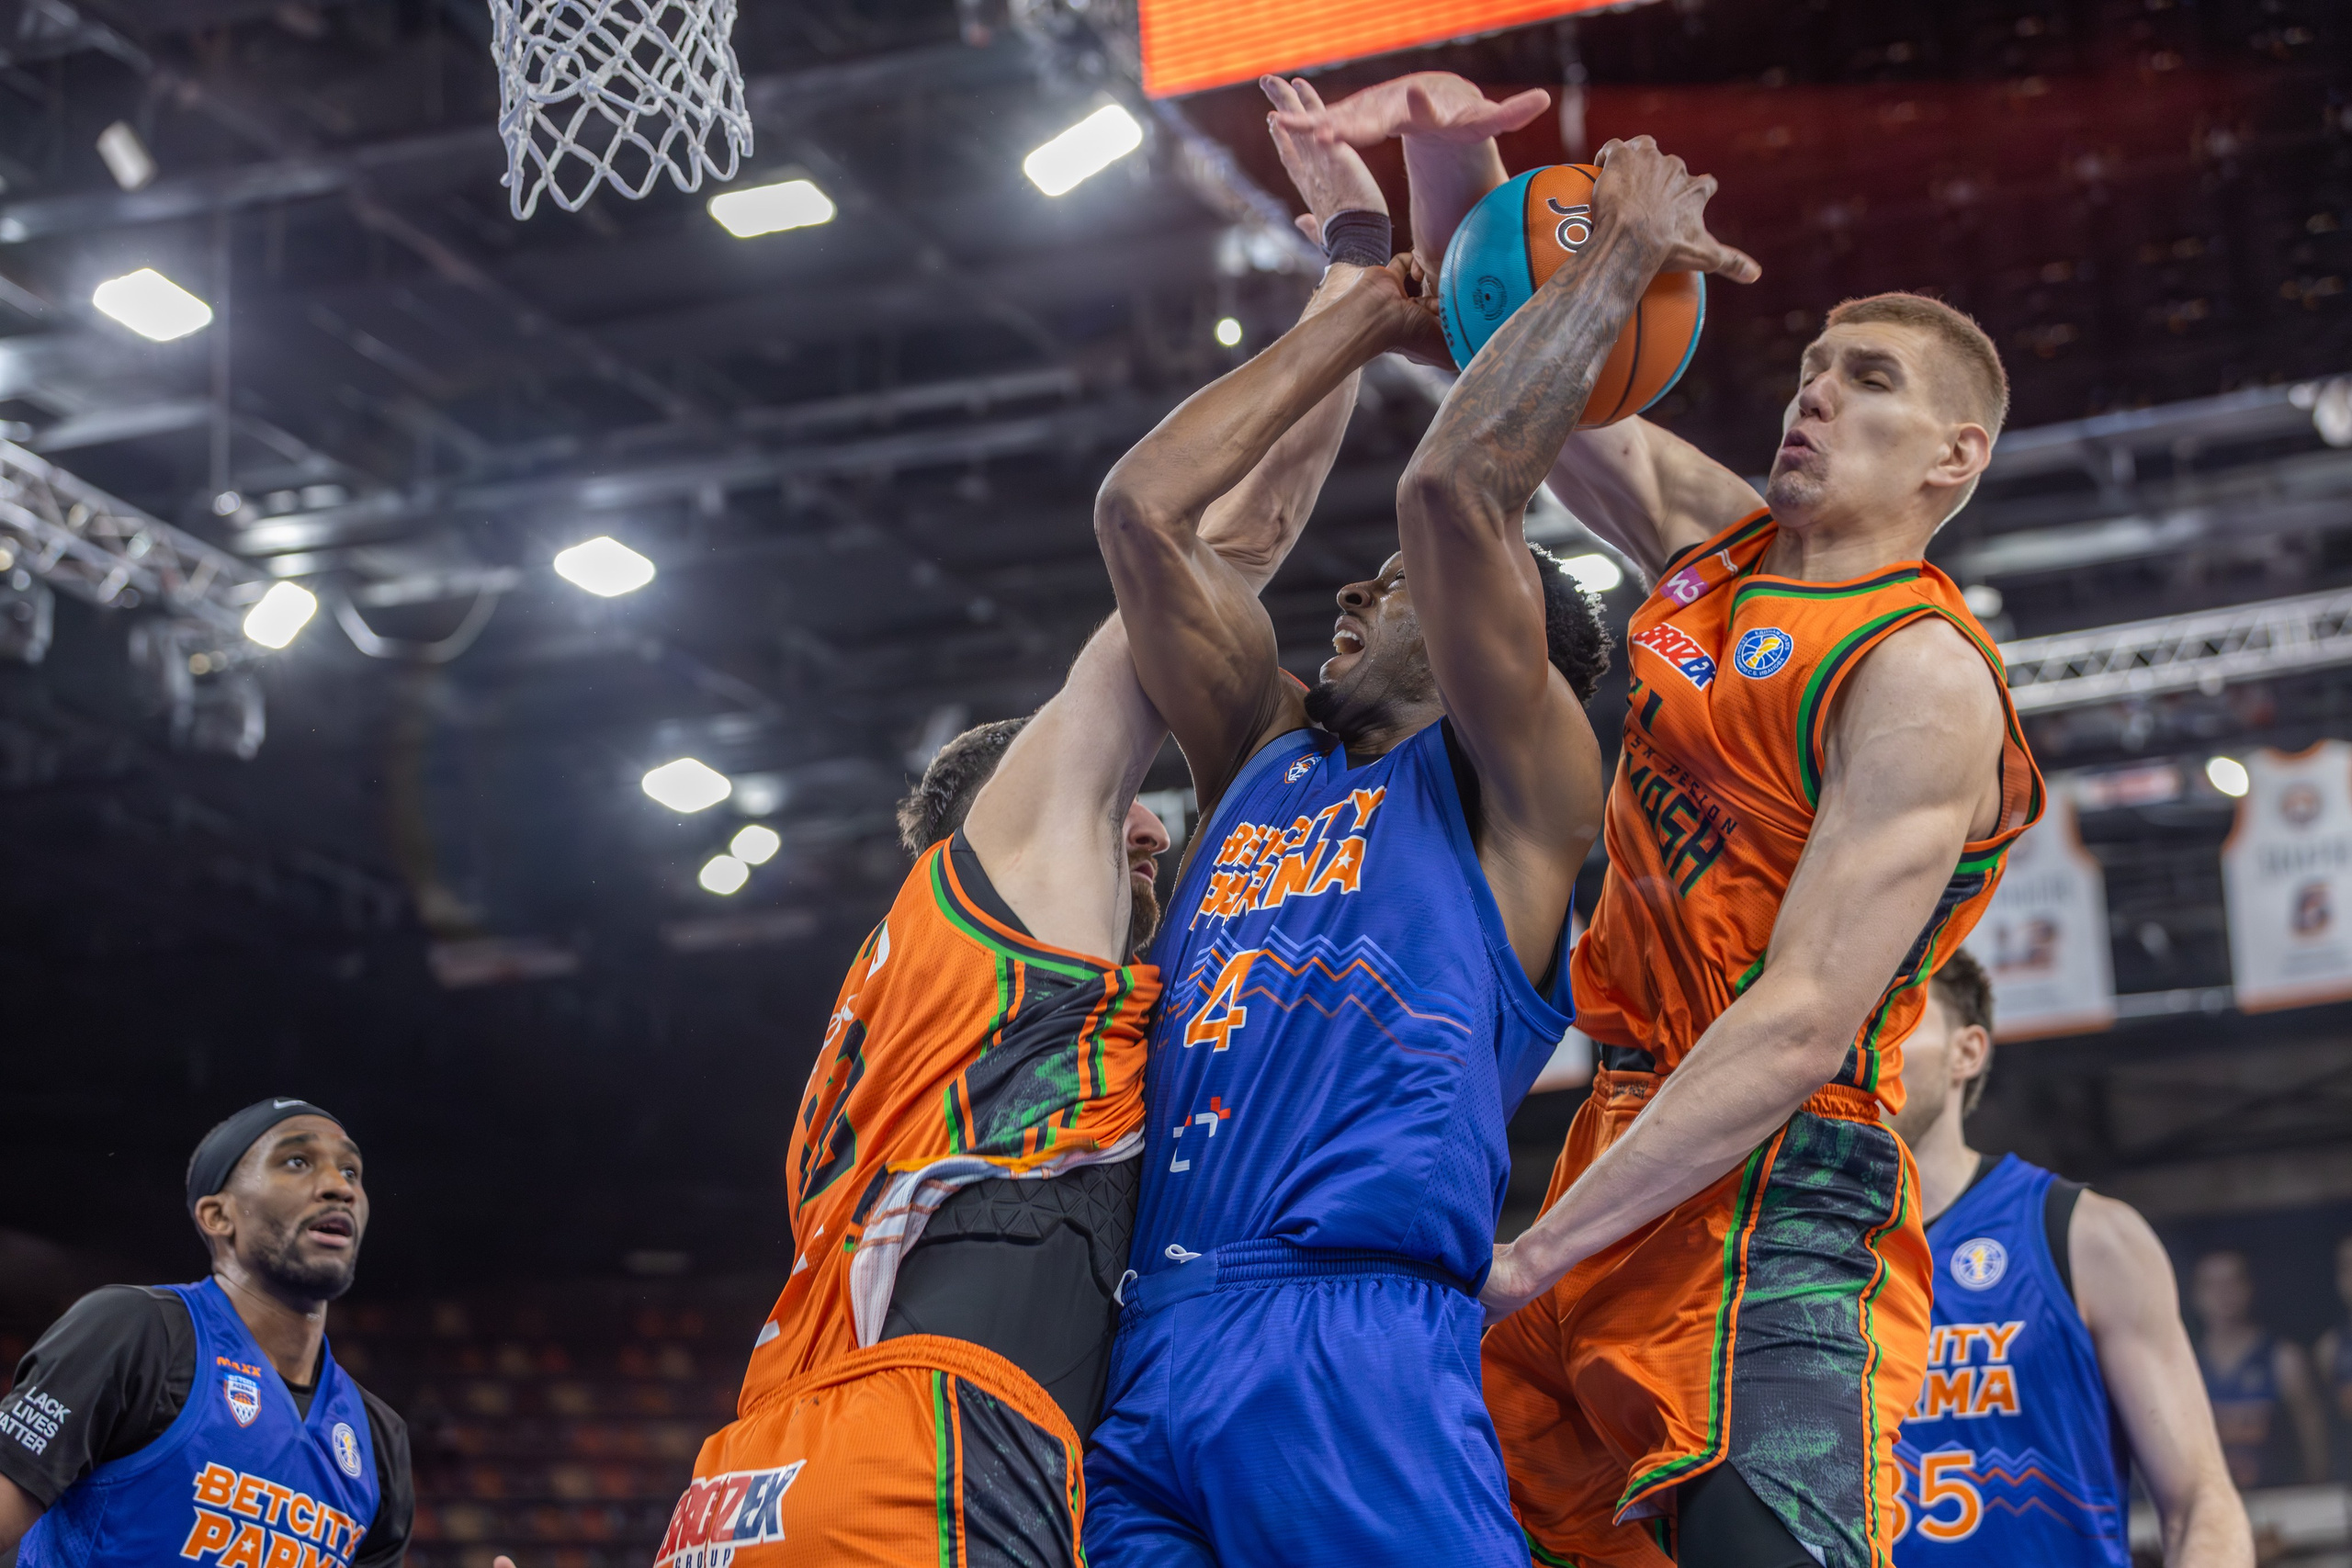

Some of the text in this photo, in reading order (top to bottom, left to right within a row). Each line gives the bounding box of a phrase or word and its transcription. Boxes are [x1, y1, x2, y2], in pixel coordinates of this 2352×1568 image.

[1184, 949, 1260, 1052] 4
[1928, 1321, 2026, 1367] ITY
[12, 1400, 59, 1439] LIVES
[192, 1461, 368, 1560] BETCITY
